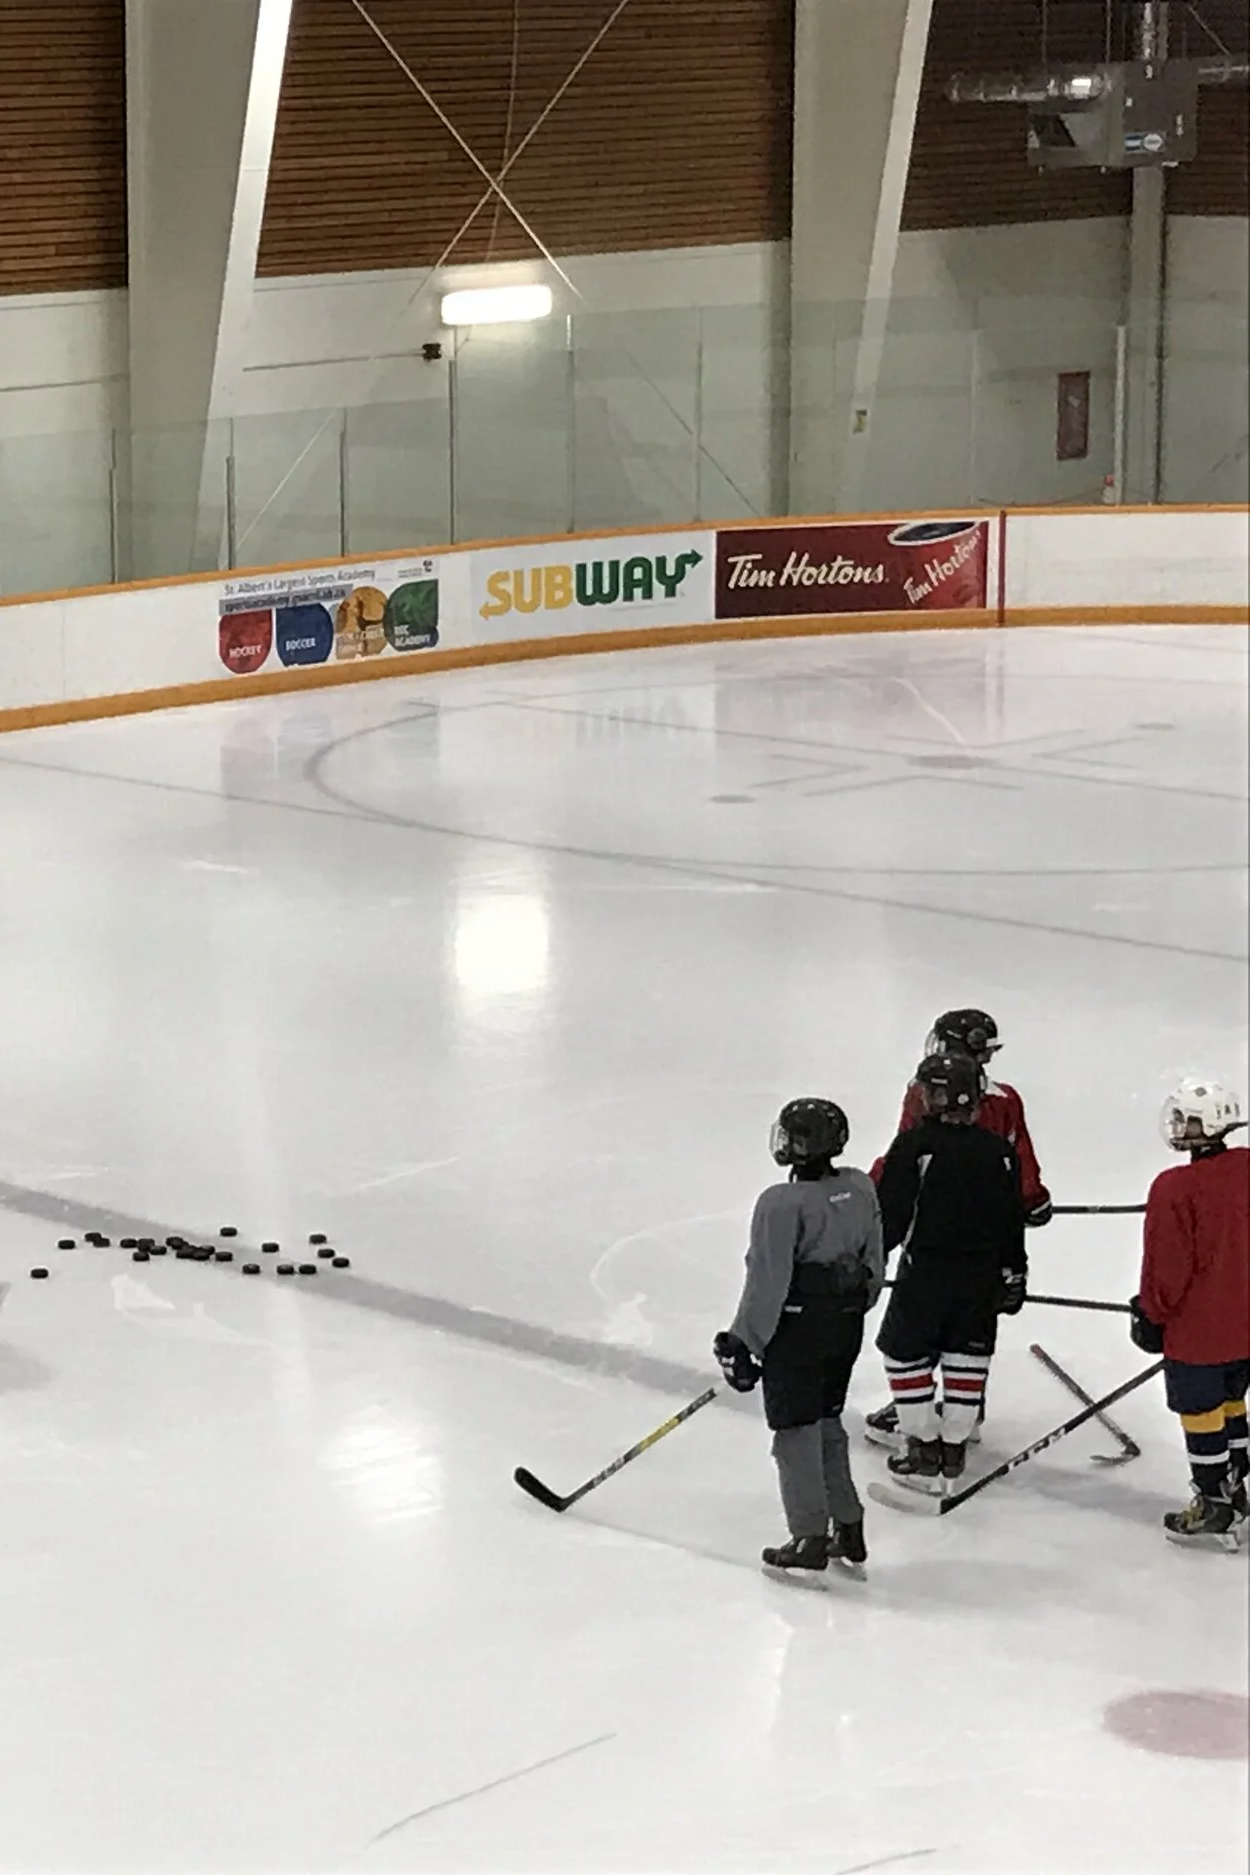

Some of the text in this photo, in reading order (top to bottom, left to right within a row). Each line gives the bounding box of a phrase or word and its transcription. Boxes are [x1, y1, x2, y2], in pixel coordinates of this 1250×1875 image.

[337, 569, 376, 582] Academy
[727, 550, 886, 589] Tim Hortons
[479, 549, 704, 621] SUBWAY
[903, 576, 933, 604] Tim
[285, 637, 317, 651] SOCCER
[394, 633, 431, 647] ACADEMY
[229, 645, 262, 659] HOCKEY
